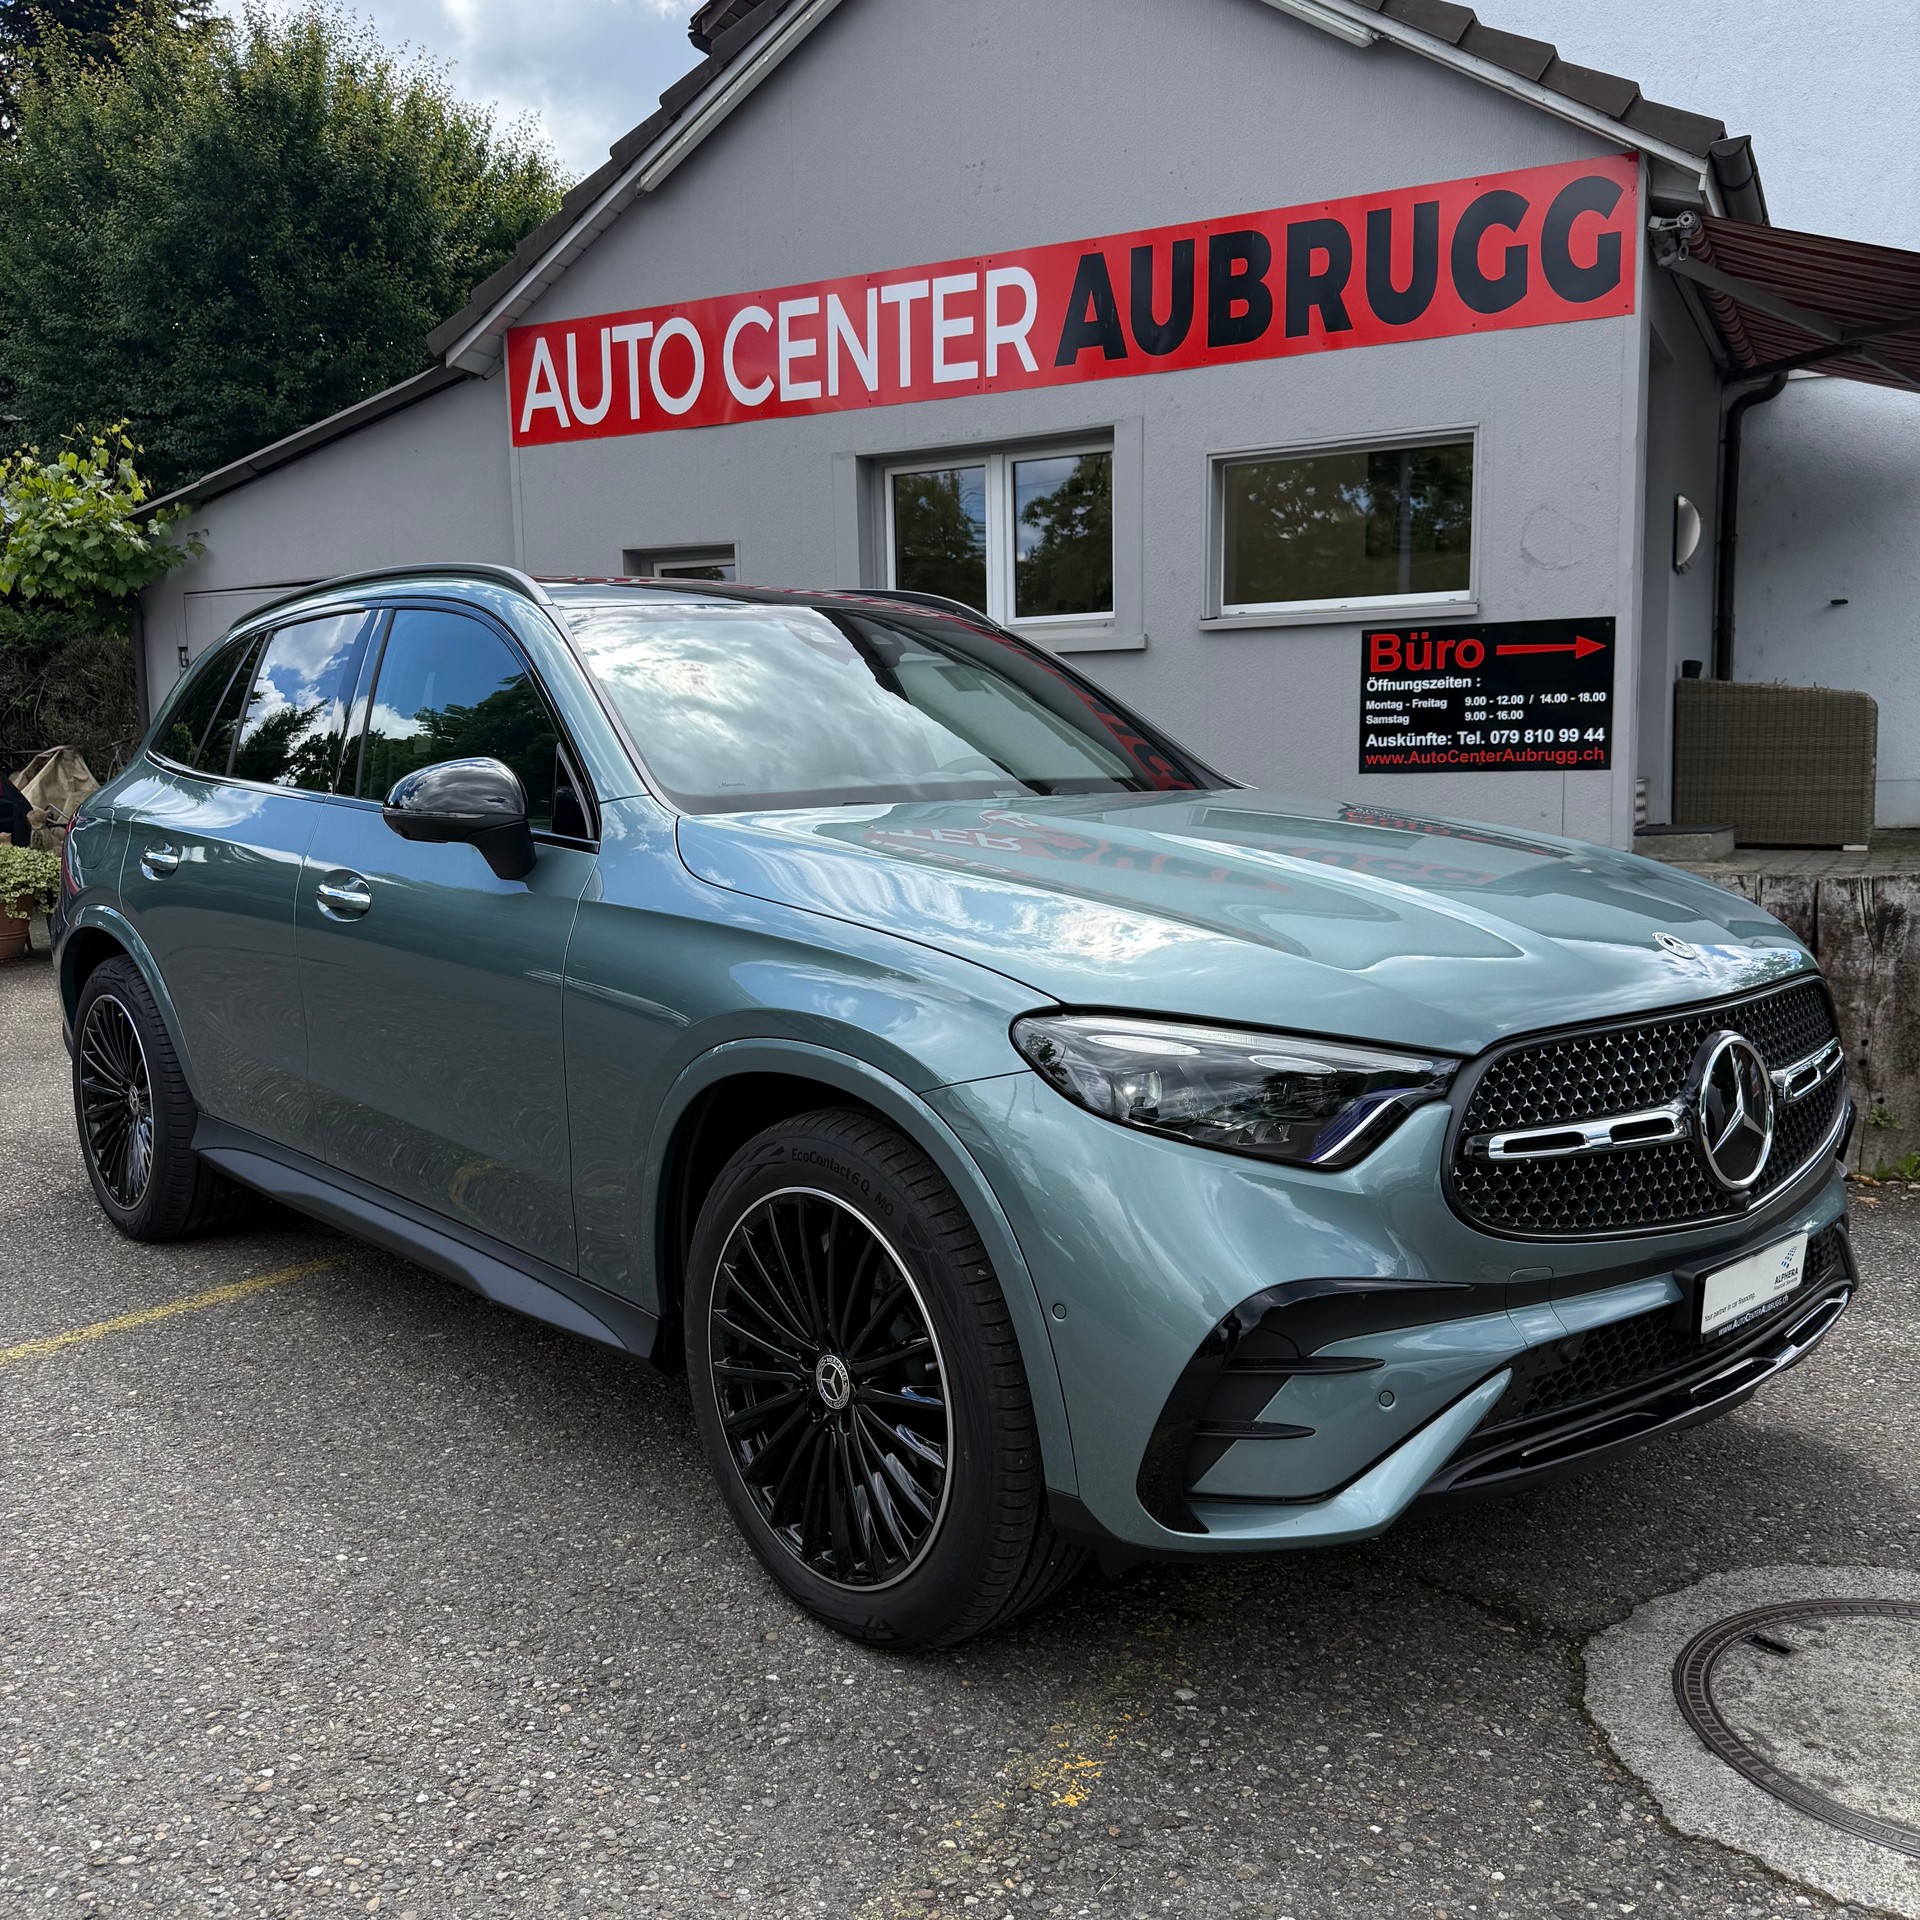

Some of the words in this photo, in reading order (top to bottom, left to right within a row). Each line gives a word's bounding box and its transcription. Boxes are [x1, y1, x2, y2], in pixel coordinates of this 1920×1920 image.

[520, 317, 705, 433] AUTO
[723, 267, 1039, 406] CENTER
[1054, 176, 1624, 367] AUBRUGG
[1370, 631, 1485, 673] Büro
[1366, 676, 1472, 693] Öffnungszeiten
[1366, 700, 1404, 711] Montag
[1412, 698, 1448, 710] Freitag
[1464, 696, 1487, 707] 9.00
[1496, 694, 1524, 706] 12.00
[1540, 693, 1568, 704] 14.00
[1578, 691, 1607, 703] 18.00
[1366, 715, 1410, 726] Samstag
[1464, 711, 1487, 722] 9.00
[1496, 710, 1524, 721] 16.00
[1365, 732, 1453, 747] Auskünfte:
[1457, 731, 1485, 745] Tel.
[1490, 730, 1520, 744] 079
[1524, 729, 1554, 743] 810
[1558, 728, 1579, 742] 99
[1583, 727, 1605, 742] 44
[1365, 747, 1605, 766] www.AutoCenterAubrugg.ch
[791, 1148, 851, 1180] EcoContact
[851, 1172, 861, 1185] 6
[874, 1191, 894, 1217] MO
[1774, 1267, 1799, 1285] ALPHERA
